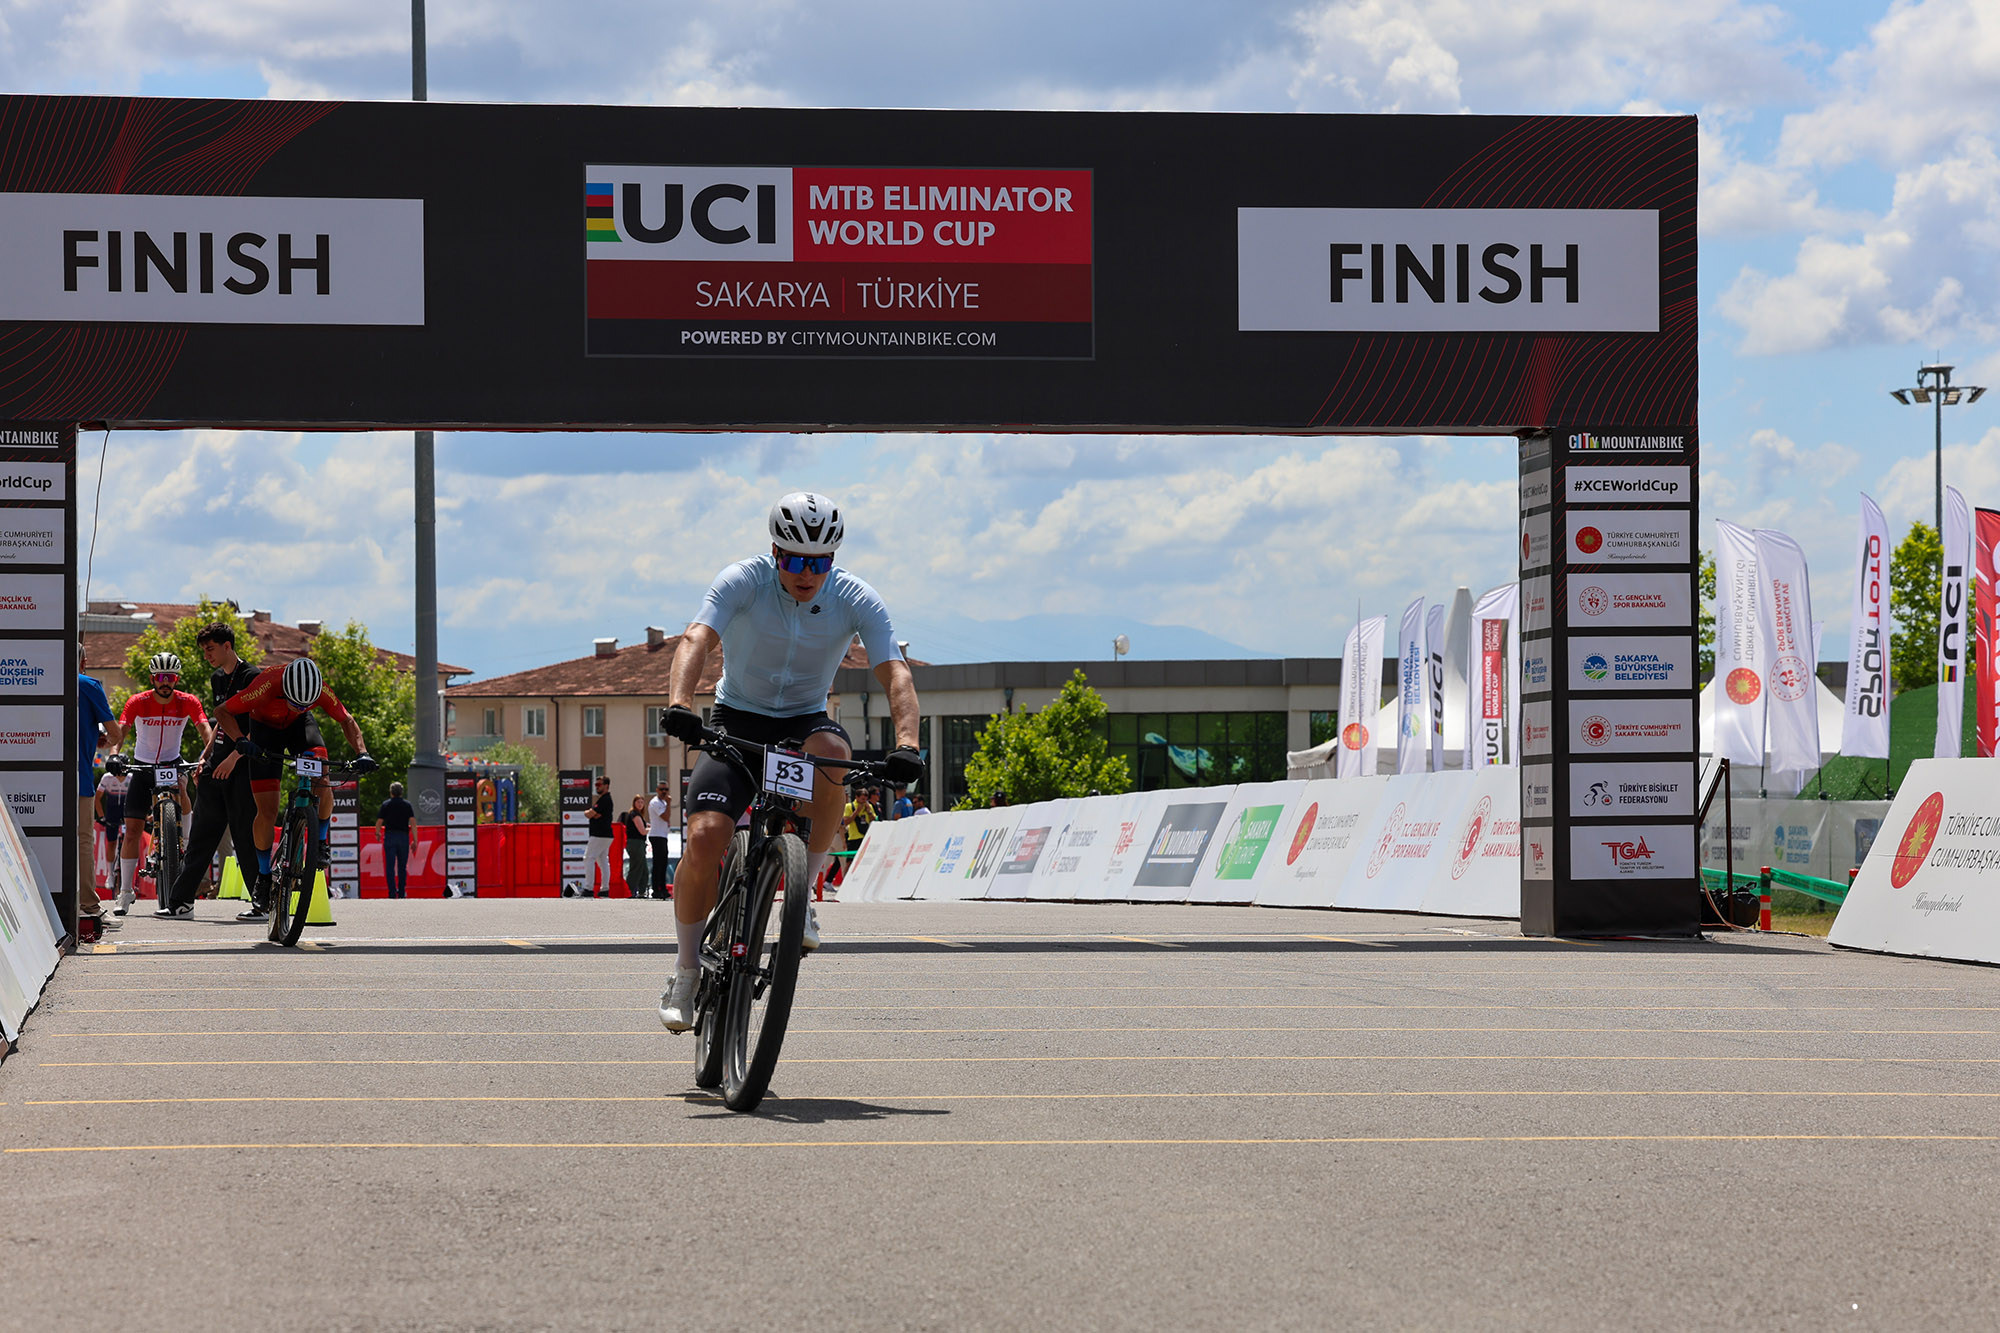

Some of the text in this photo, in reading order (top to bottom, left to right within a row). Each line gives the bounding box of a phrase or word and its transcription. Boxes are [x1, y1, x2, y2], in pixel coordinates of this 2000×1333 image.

[809, 185, 1074, 213] MTB ELIMINATOR
[622, 183, 776, 244] UCI
[808, 220, 996, 246] WORLD CUP
[63, 230, 330, 295] FINISH
[1330, 243, 1579, 304] FINISH
[695, 276, 980, 309] SAKARYA TÜRKİYE
[681, 330, 997, 347] POWERED BY CITYMOUNTAINBIKE.COM
[1568, 432, 1684, 449] CITY MOUNTAINBIKE
[1574, 480, 1678, 494] #XCEWorldCup
[1635, 531, 1680, 539] CUMHURİYETİ
[1607, 540, 1680, 549] CUMHURBAŞKANLIĞI
[1625, 594, 1653, 603] GENÇLİK
[1614, 654, 1659, 663] SAKARYA
[1614, 662, 1674, 673] BÜYÜKŞEHİR
[1614, 672, 1668, 681] BELEDİYESİ
[1432, 652, 1443, 719] UCI
[142, 718, 183, 727] TÜRKİYE
[1640, 723, 1681, 731] CUMHURİYETİ
[1486, 722, 1499, 757] UCI
[303, 761, 315, 771] 51
[160, 770, 174, 780] 50
[776, 761, 804, 783] 53
[1619, 783, 1678, 793] TÜRKİYE BİSİKLET
[14, 792, 46, 803] BİSİKLET
[448, 796, 474, 805] START
[563, 796, 589, 805] START
[1619, 795, 1668, 804] FEDERASYONU
[1944, 812, 1984, 836] TÜRKİYE
[1601, 835, 1655, 865] TGA
